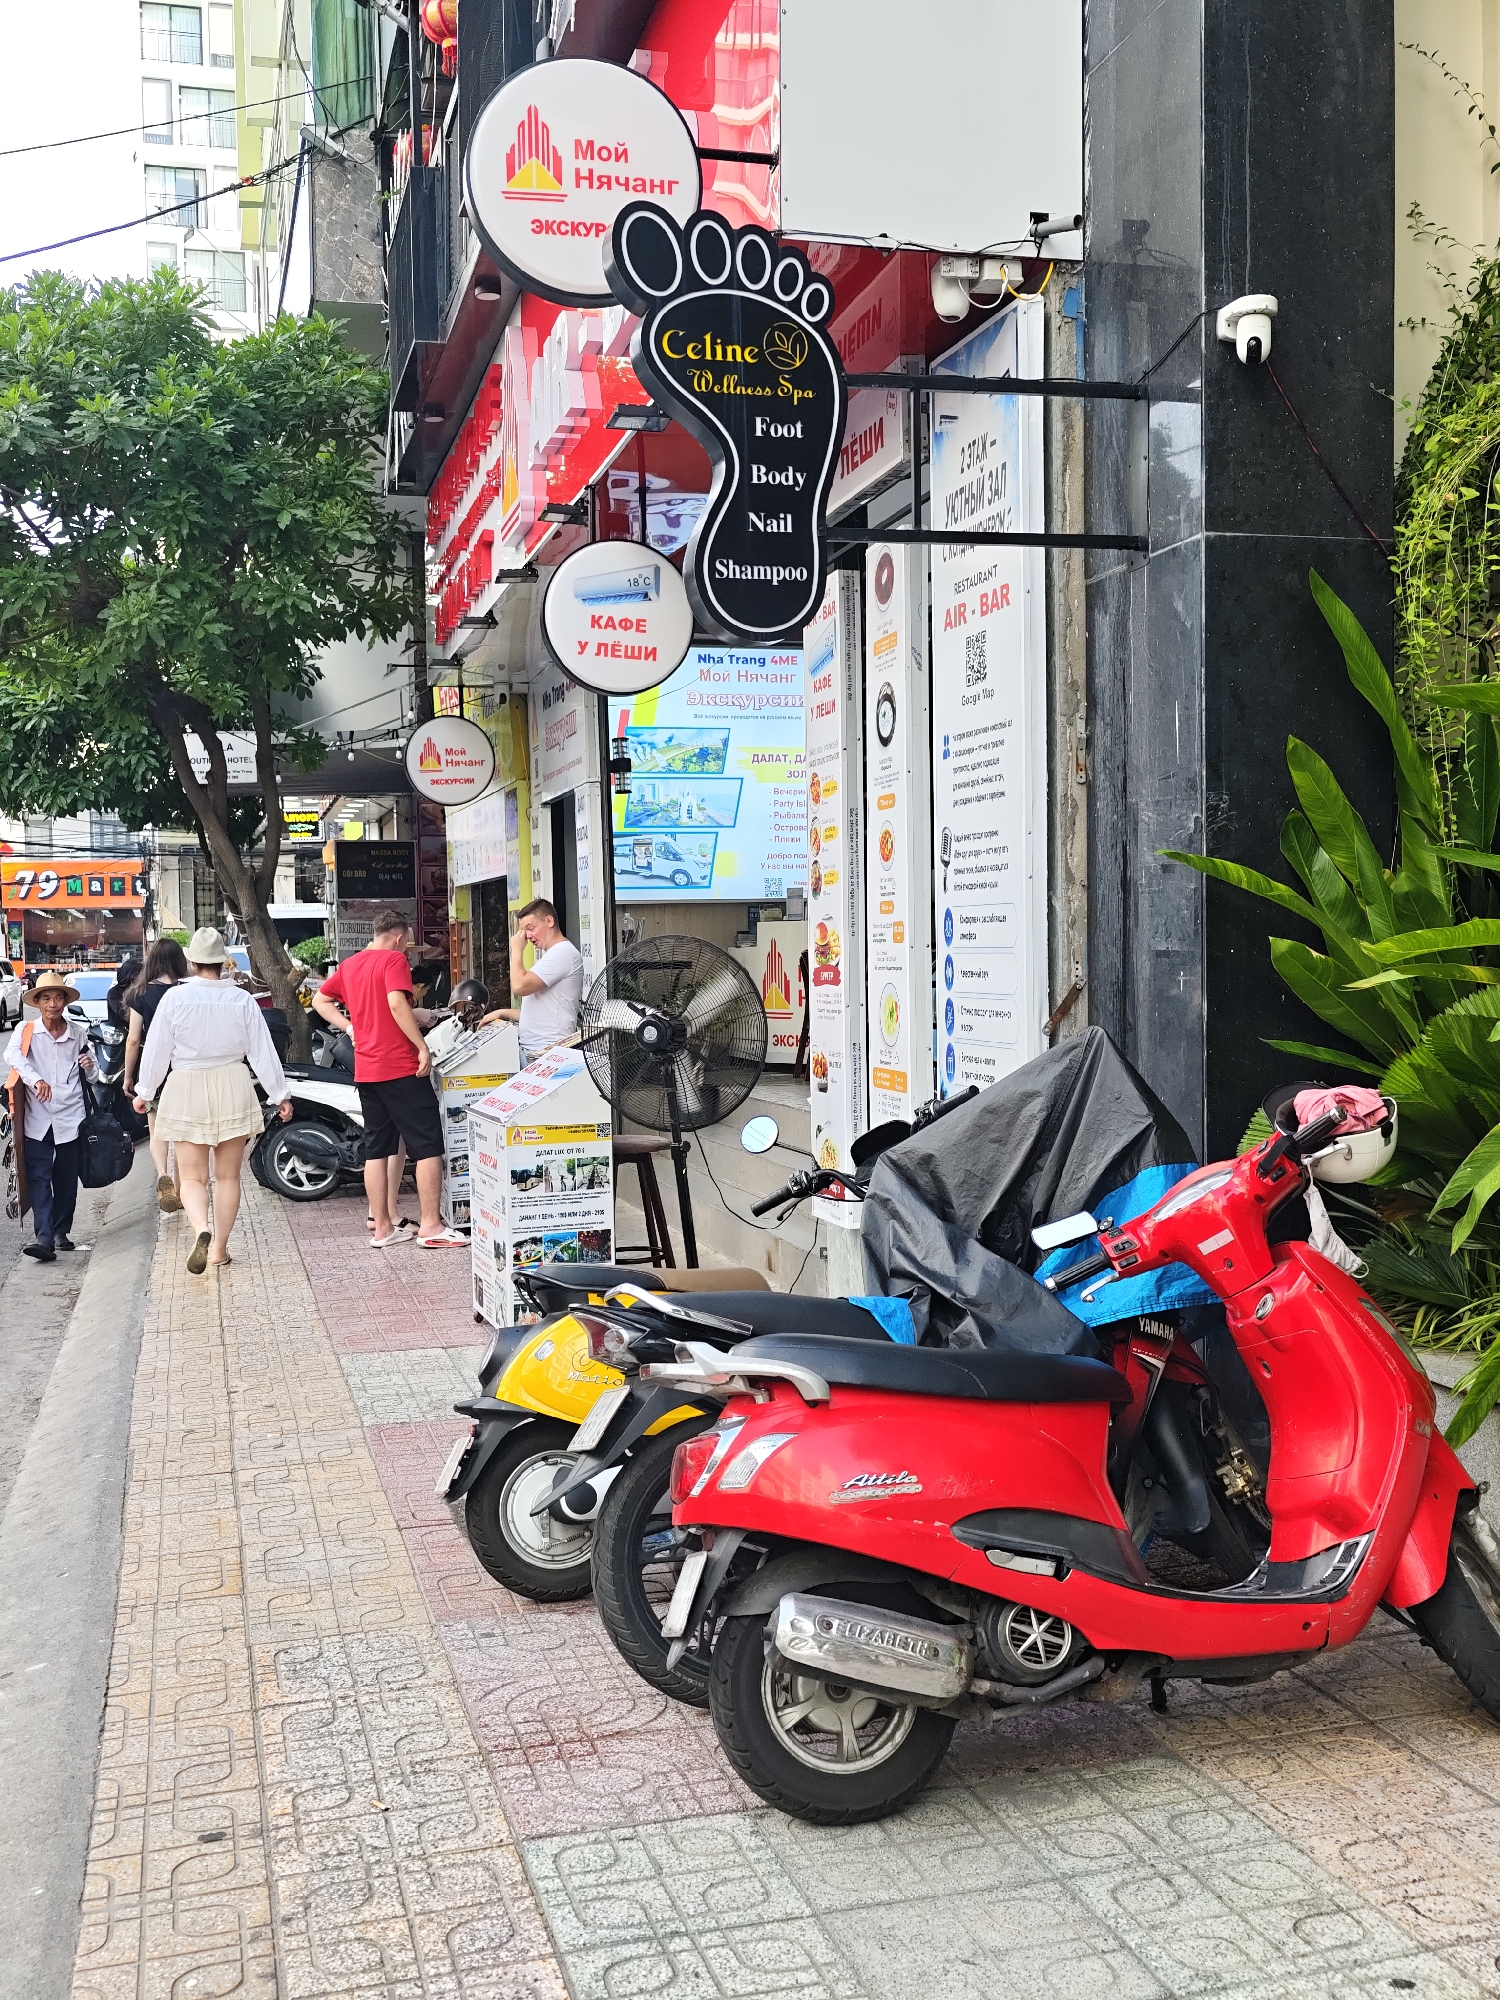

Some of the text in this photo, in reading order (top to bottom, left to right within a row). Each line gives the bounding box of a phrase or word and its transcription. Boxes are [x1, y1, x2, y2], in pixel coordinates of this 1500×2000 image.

[574, 139, 629, 165] Мой
[574, 167, 679, 196] Нячанг
[530, 218, 612, 238] ЭКСКУР
[661, 329, 759, 363] Celine
[686, 367, 818, 405] Wellness Spa
[754, 416, 804, 439] Foot
[967, 431, 988, 470] ЭТАЖ
[750, 464, 807, 491] Body
[945, 461, 1006, 529] УЮТНЫЙ ЗАЛ
[748, 512, 793, 533] Nail
[715, 559, 808, 585] Shampoo
[953, 564, 998, 595] RESTAURANT
[944, 602, 968, 632] AIR
[980, 583, 1010, 617] BAR
[590, 614, 647, 634] КАФЕ
[577, 641, 658, 662] У ЛЁШИ
[697, 654, 724, 665] Nha
[728, 654, 766, 667] Trang
[699, 668, 797, 683] Мой Нячанг
[813, 673, 832, 694] КАФЕ
[687, 690, 805, 710] Экскурсии
[816, 698, 836, 720] ЛЁШИ
[445, 747, 466, 757] Мой
[751, 754, 792, 766] ДАЛАТ,
[445, 759, 485, 768] Нячанг
[430, 778, 475, 786] ЭКСКУРСИИ
[773, 800, 794, 809] Party
[14, 870, 143, 900] 79 Mart
[1138, 1316, 1174, 1341] YAMAHA
[841, 1470, 919, 1489] Attila
[832, 1619, 929, 1657] ELIZABETH
